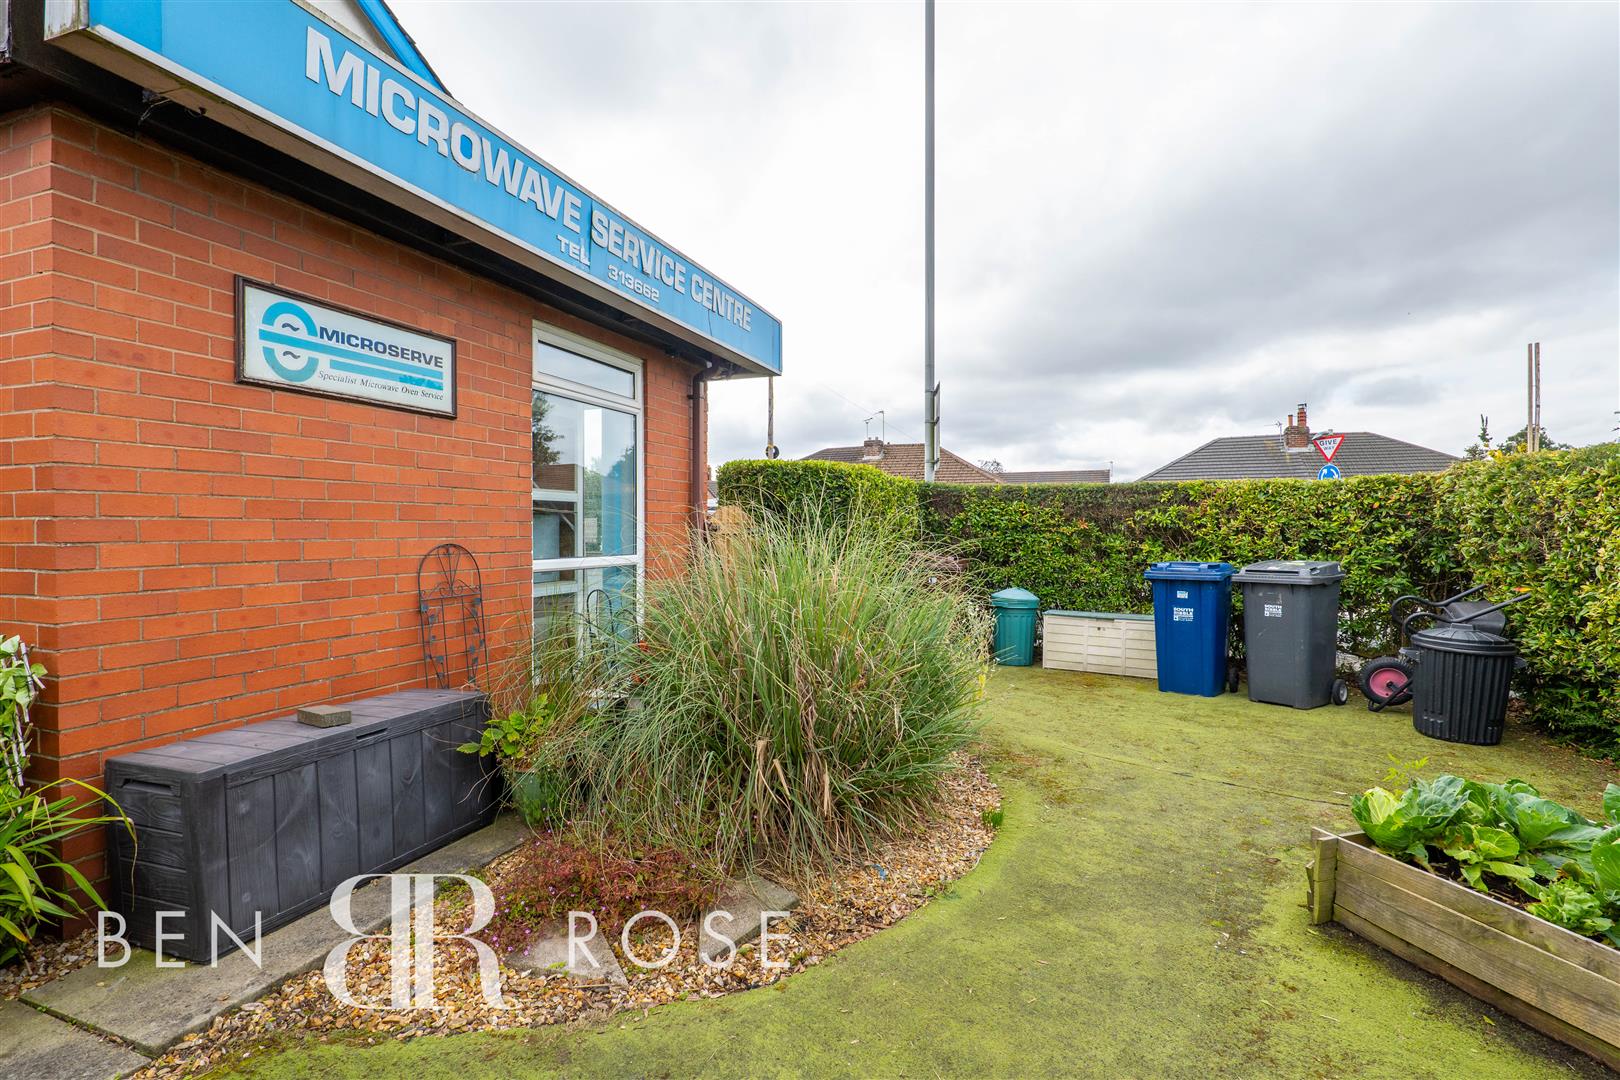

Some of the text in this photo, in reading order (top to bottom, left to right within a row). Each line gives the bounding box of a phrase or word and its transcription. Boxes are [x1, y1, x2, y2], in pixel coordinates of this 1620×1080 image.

[306, 26, 752, 332] MICROWAVE SERVICE CENTRE
[557, 234, 660, 303] TEL 313662
[319, 326, 443, 368] MICROSERVE
[319, 371, 444, 401] Specialist Microwave Oven Service
